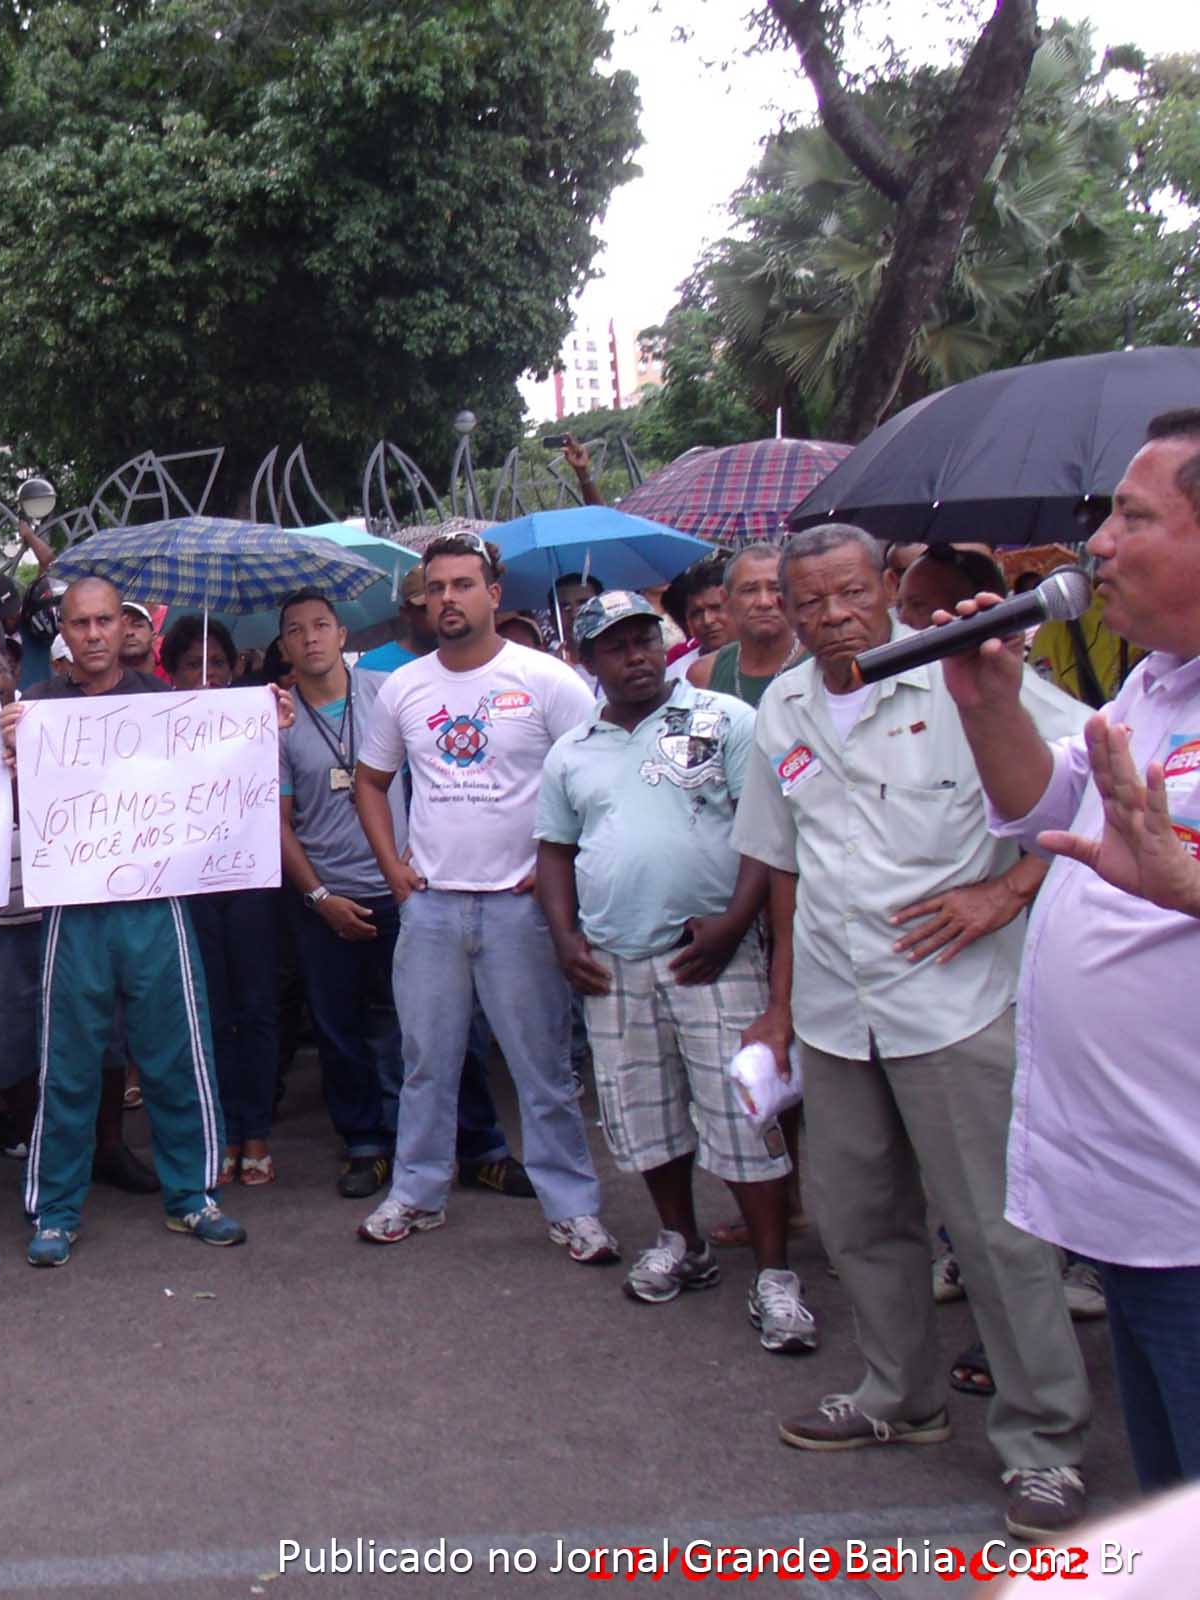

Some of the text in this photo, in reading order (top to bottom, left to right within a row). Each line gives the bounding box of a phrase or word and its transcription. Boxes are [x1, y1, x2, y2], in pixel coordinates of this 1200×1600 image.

[35, 704, 142, 777] NETO
[27, 773, 280, 842] VOTAMOS EM VOCÊ
[64, 831, 122, 866] VOCÊ
[131, 823, 174, 854] NOS
[106, 857, 170, 897] 0%
